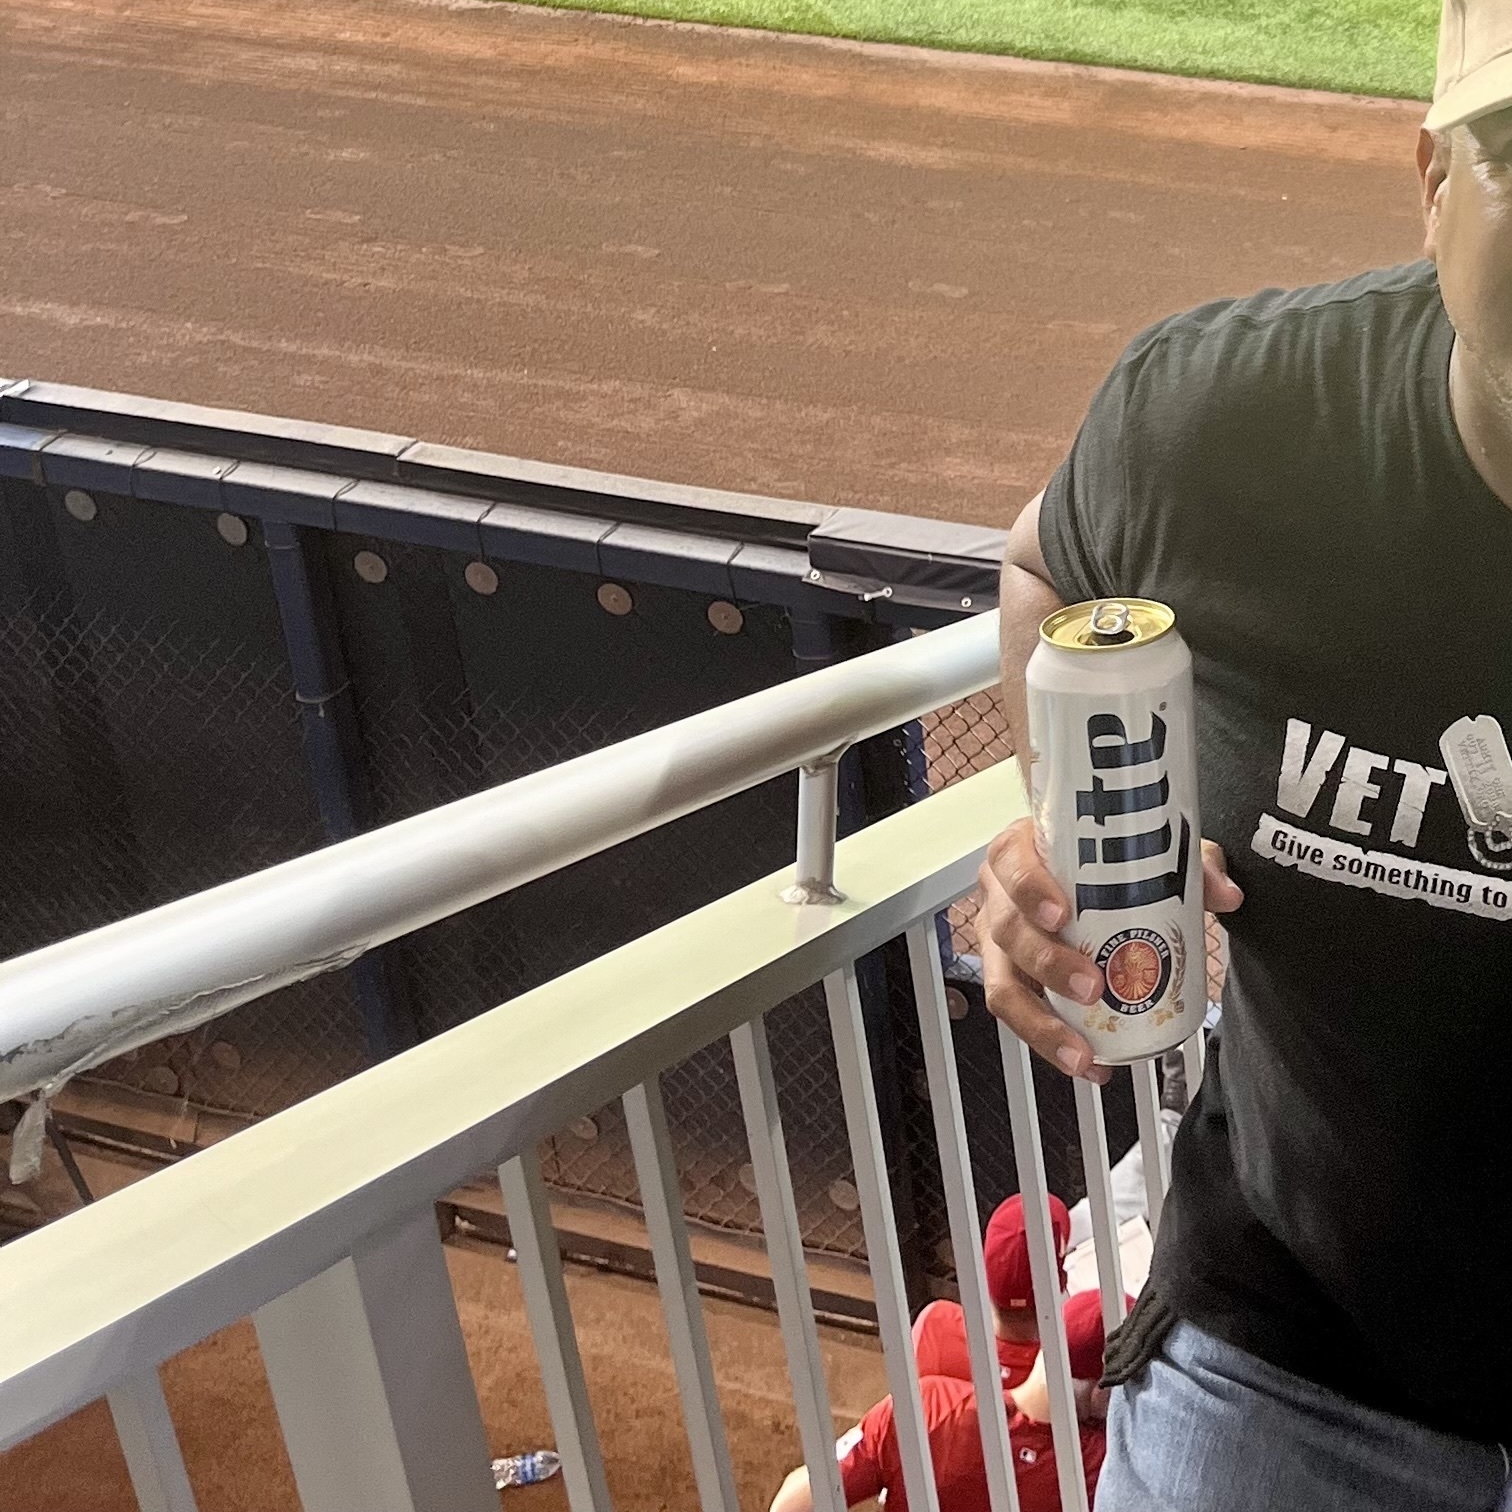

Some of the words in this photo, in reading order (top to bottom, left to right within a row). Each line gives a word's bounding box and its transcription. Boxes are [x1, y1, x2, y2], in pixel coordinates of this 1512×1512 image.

[1075, 710, 1191, 922] Lite
[1276, 717, 1448, 848] VET
[1271, 829, 1325, 866] Give
[1332, 853, 1473, 904] something
[1481, 884, 1508, 910] to
[1101, 934, 1127, 959] FINE
[1129, 929, 1170, 960] PILSNER
[1119, 998, 1155, 1014] BEER
